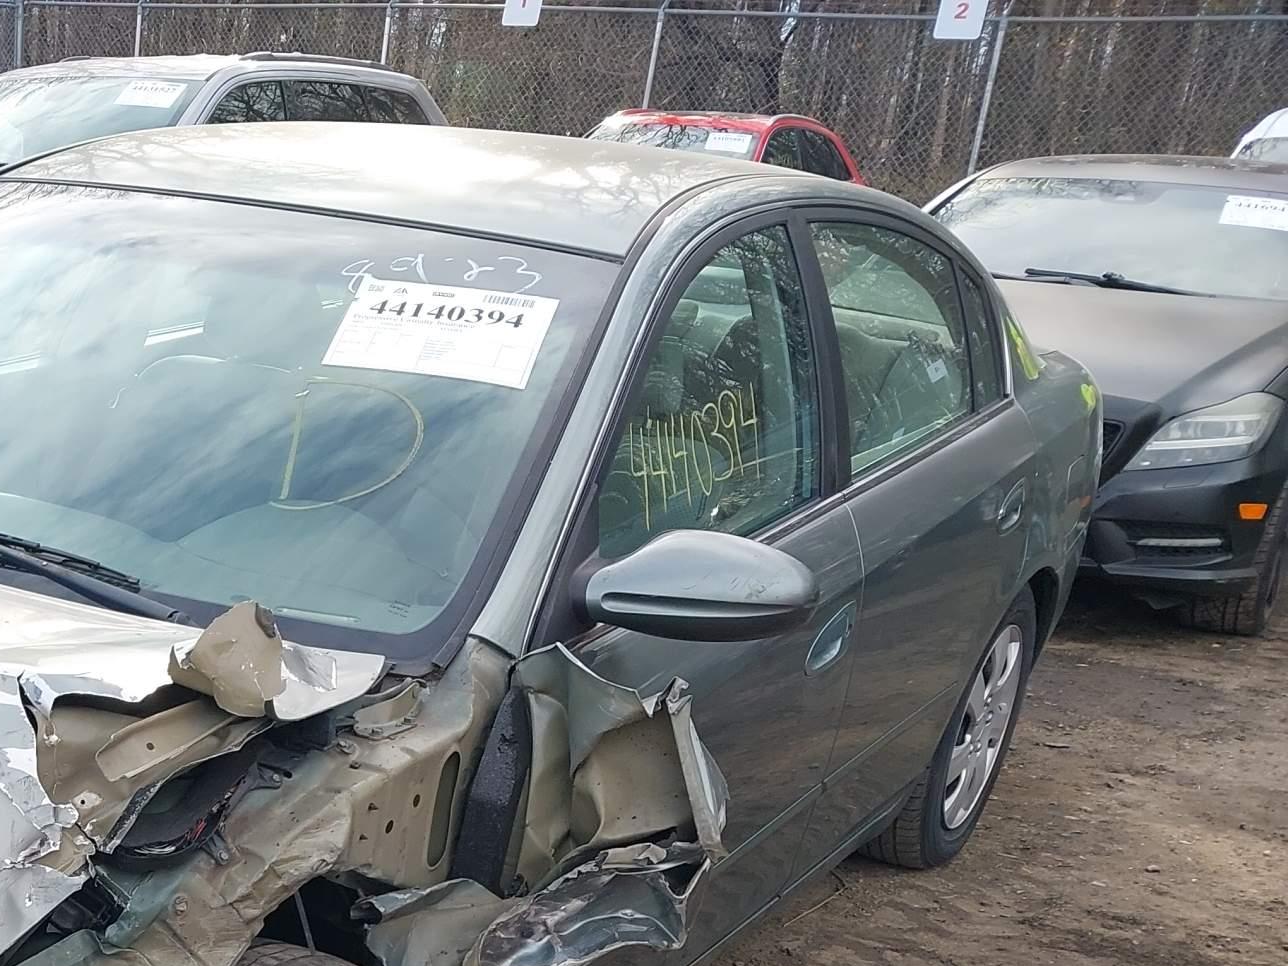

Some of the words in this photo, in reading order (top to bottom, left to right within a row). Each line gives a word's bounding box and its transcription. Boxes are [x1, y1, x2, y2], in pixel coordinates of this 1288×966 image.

[954, 3, 970, 19] 2
[369, 299, 525, 328] 44140394
[629, 381, 762, 531] 44140394
